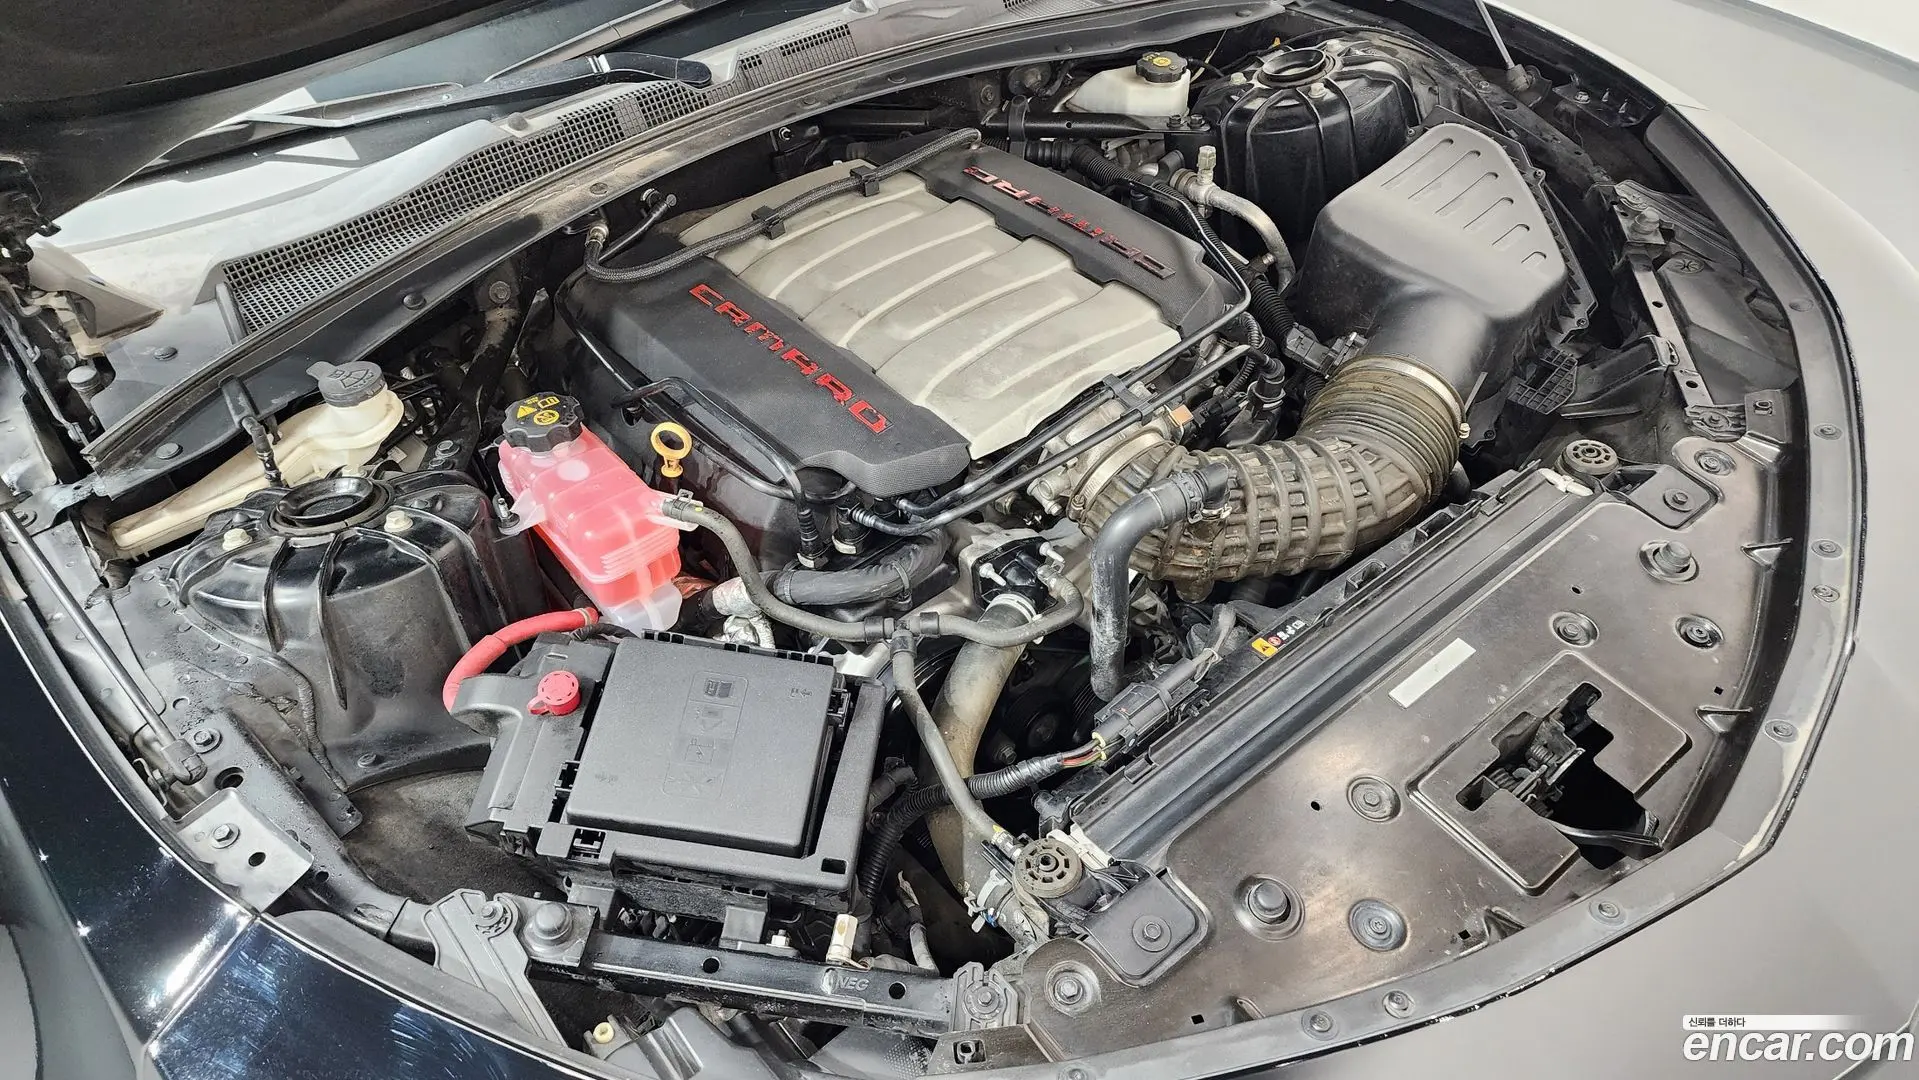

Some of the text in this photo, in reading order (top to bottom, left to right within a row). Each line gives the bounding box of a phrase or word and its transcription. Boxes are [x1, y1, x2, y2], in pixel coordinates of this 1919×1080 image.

[963, 166, 1176, 280] CAMARO
[689, 283, 892, 434] CAMARO
[839, 976, 870, 991] NEG
